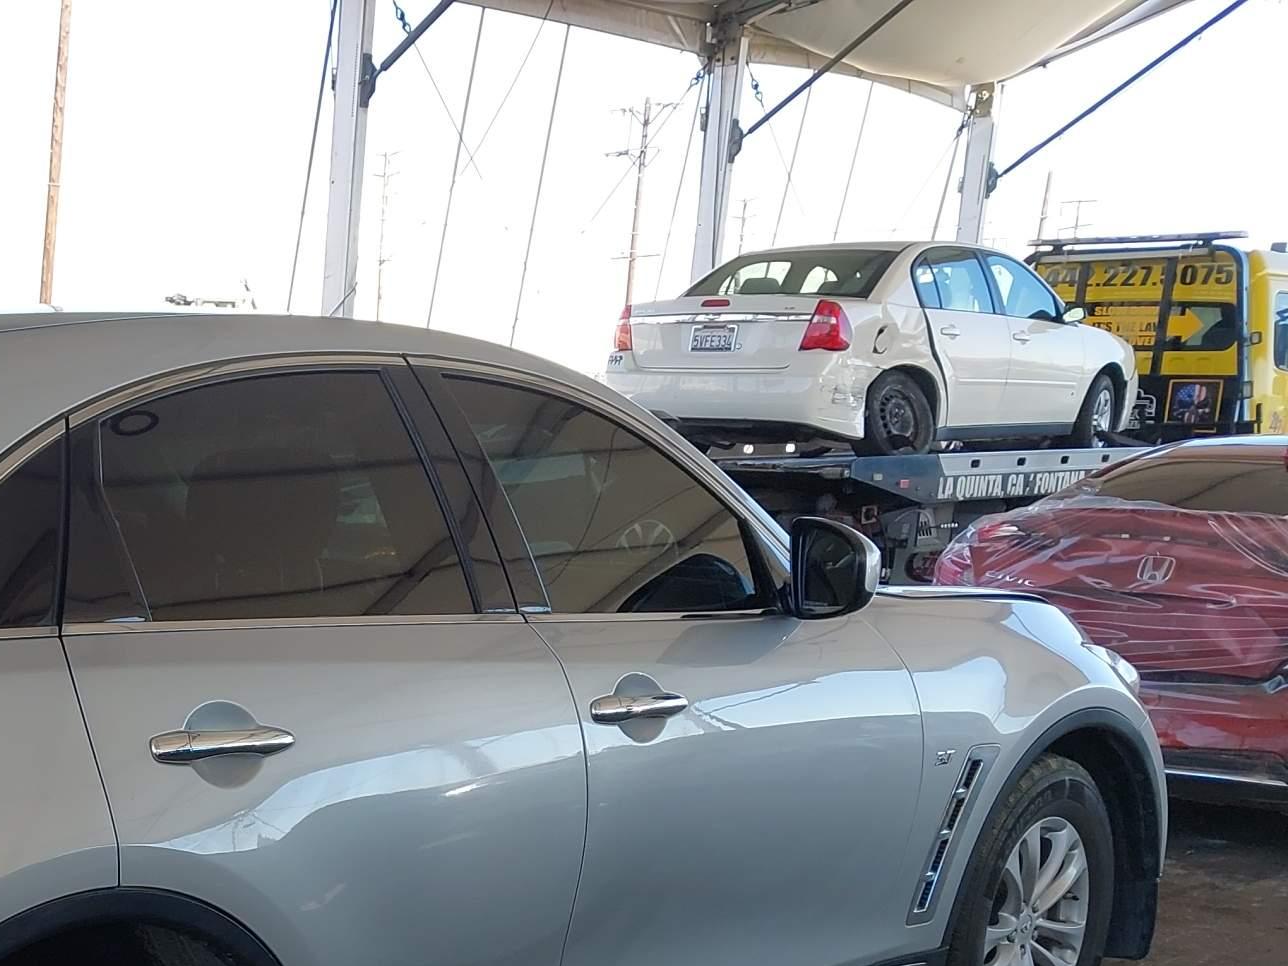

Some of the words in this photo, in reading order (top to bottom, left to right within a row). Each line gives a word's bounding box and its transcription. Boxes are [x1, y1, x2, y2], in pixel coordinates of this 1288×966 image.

[937, 476, 953, 499] LA
[956, 474, 1004, 500] QUINTA,
[1006, 473, 1024, 497] CA
[985, 570, 1037, 588] CIVIC
